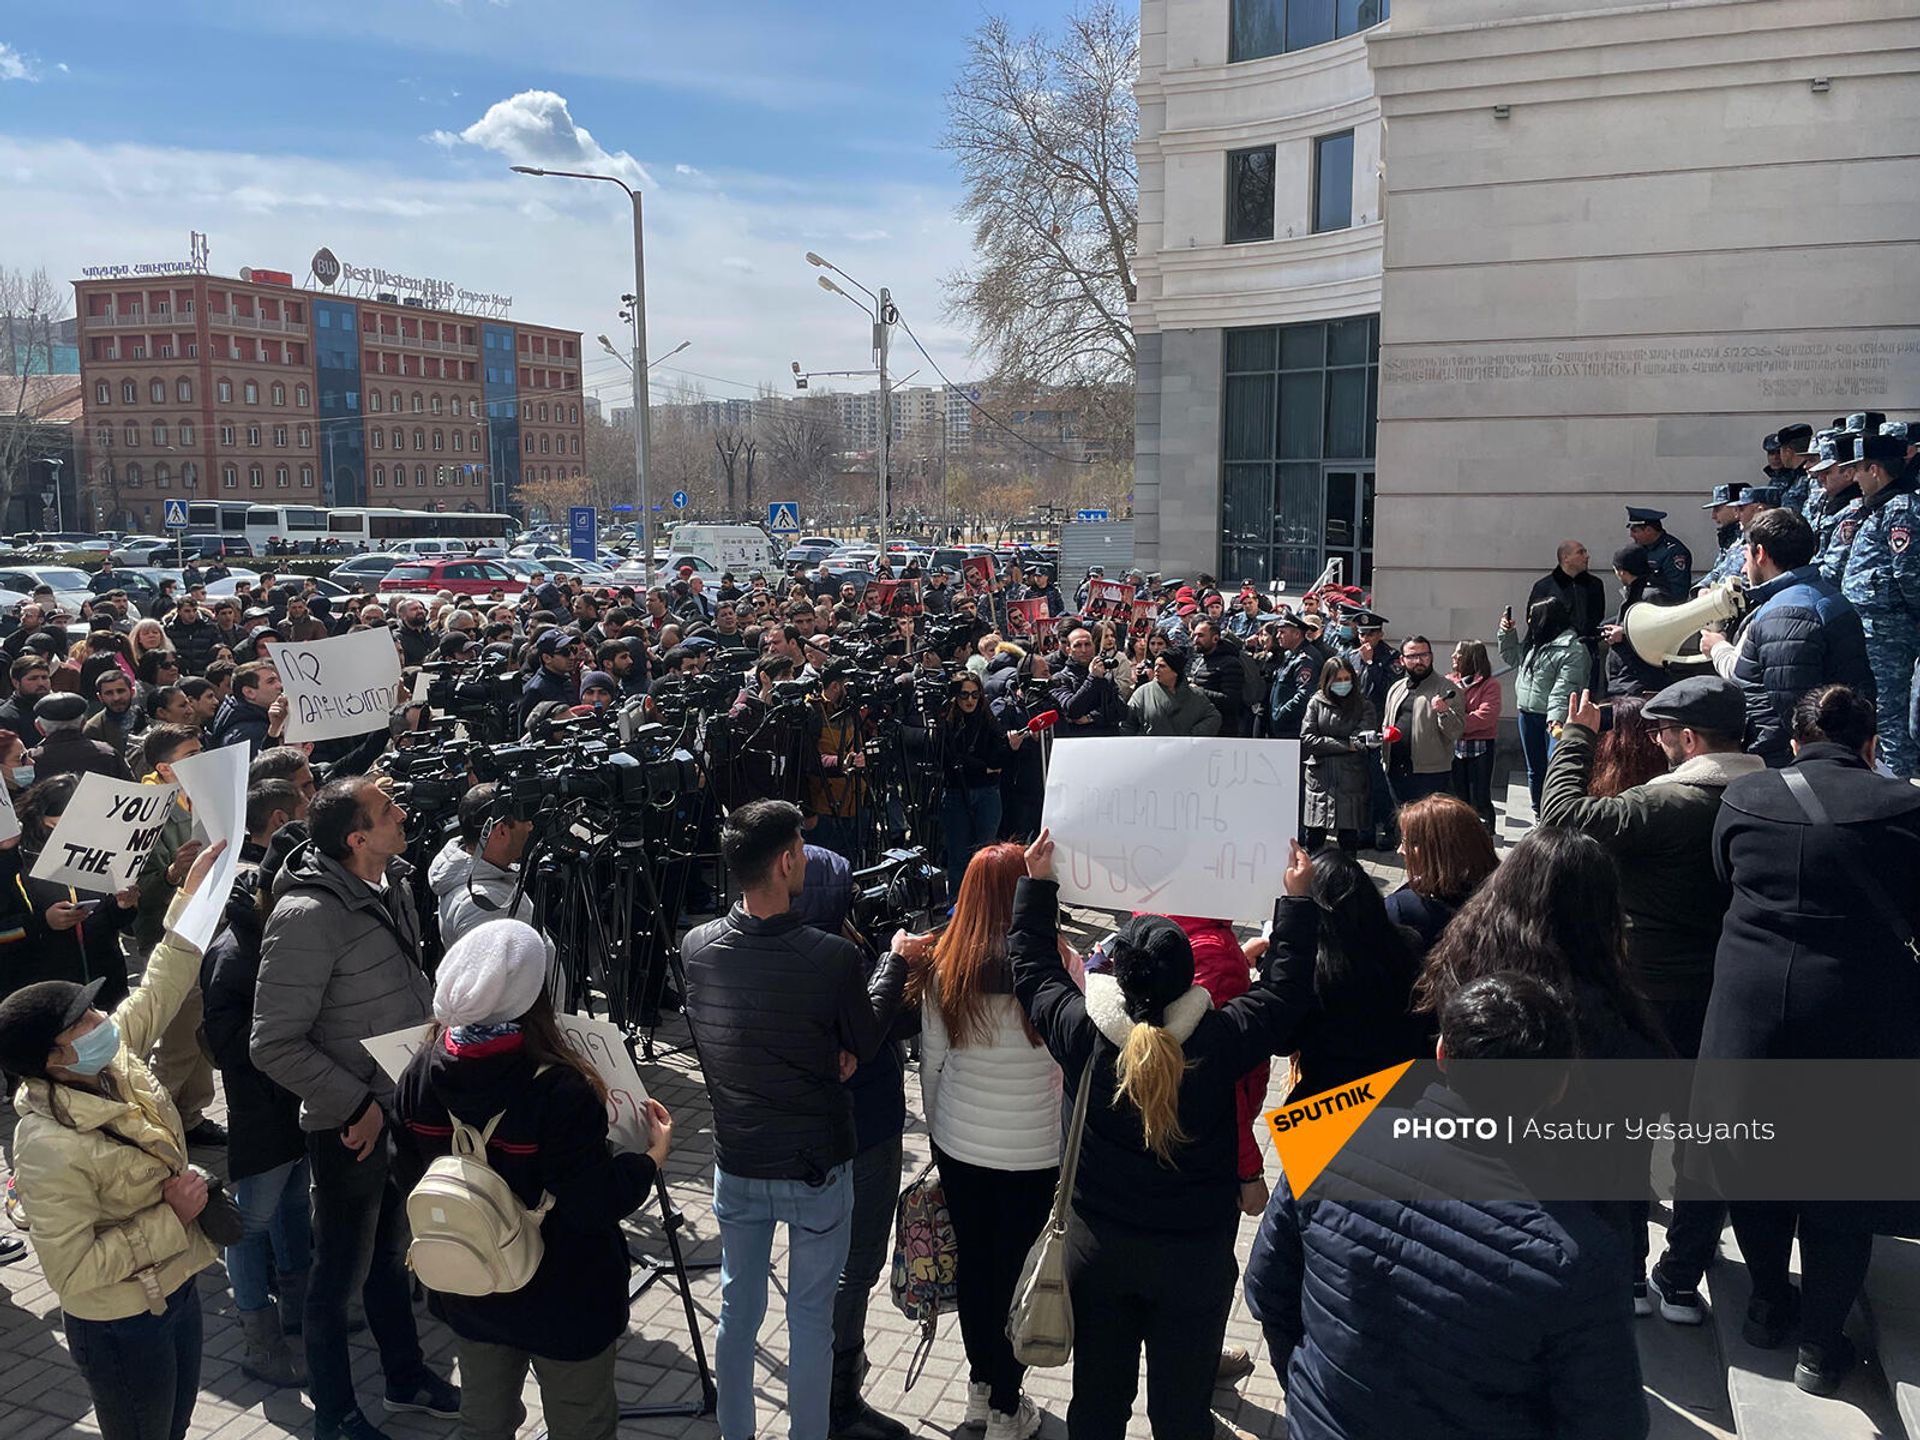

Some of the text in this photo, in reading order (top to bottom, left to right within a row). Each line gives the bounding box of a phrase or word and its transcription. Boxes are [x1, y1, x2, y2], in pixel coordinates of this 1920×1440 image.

[316, 259, 338, 275] BW
[343, 262, 372, 283] Best
[373, 268, 424, 291] Western
[424, 278, 455, 298] PLUS
[106, 794, 160, 823] YOU
[126, 823, 164, 851] NOT
[63, 842, 116, 875] THE
